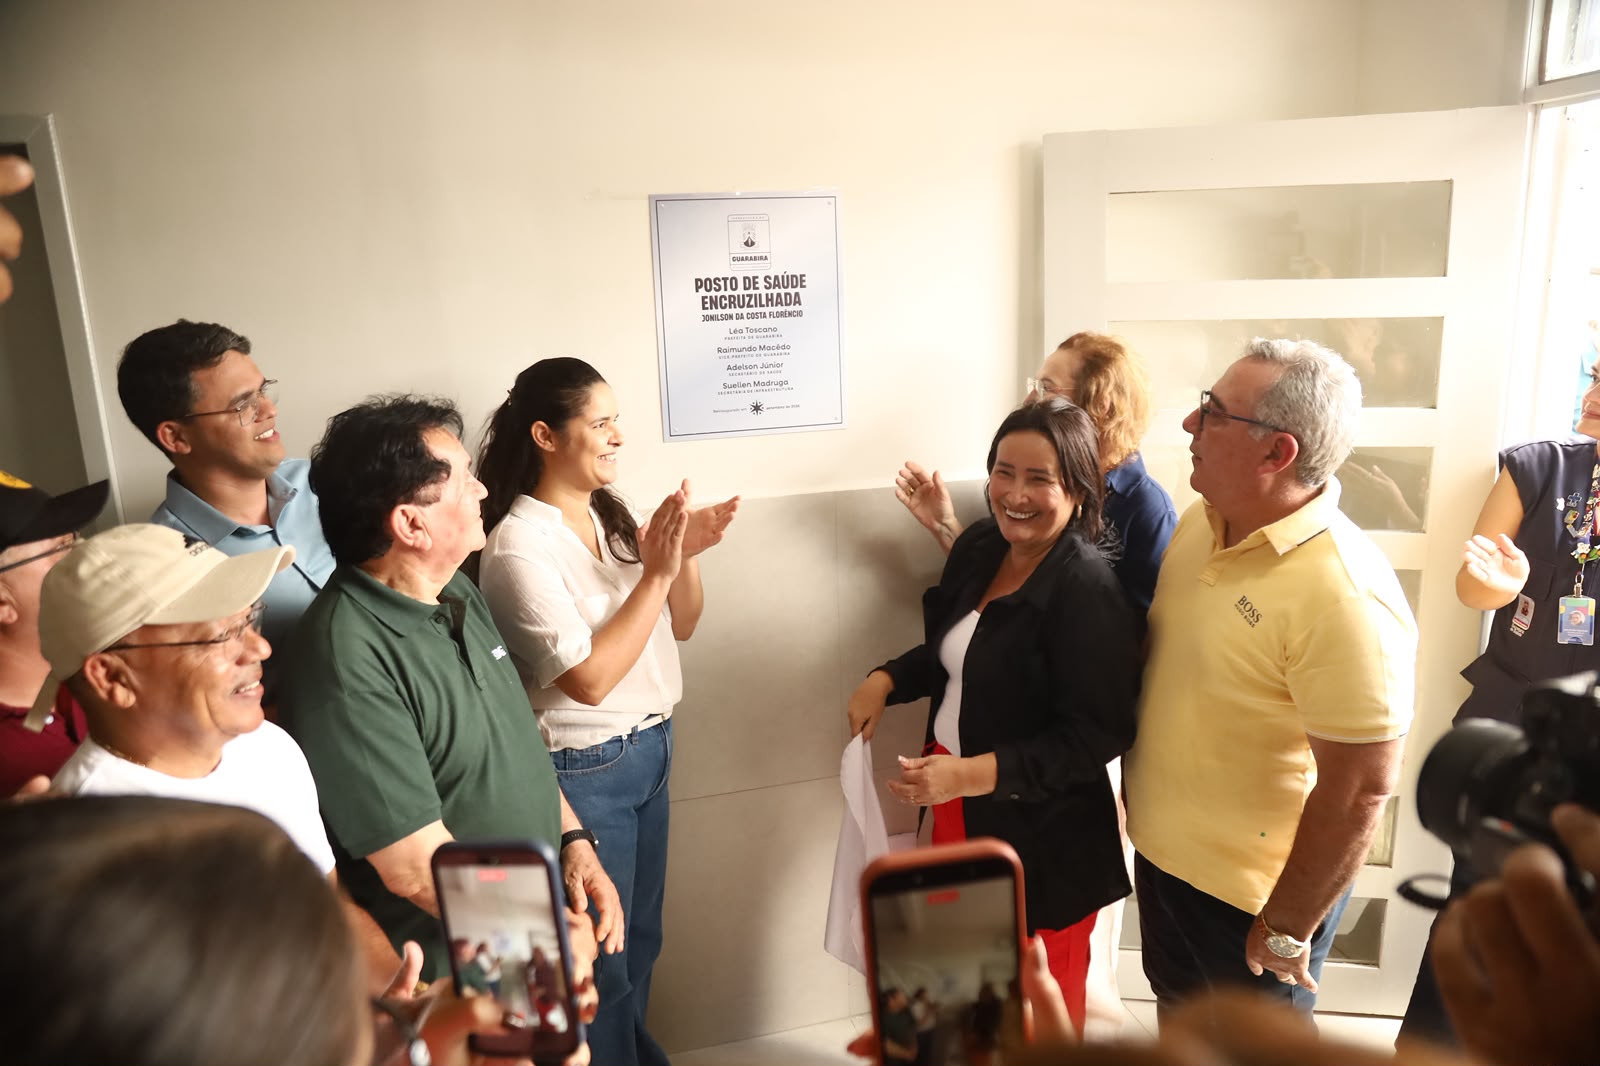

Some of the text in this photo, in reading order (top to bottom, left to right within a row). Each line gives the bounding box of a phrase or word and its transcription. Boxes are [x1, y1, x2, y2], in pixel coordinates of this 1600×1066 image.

[694, 271, 807, 293] POSTO DE SAÚDE
[701, 291, 802, 311] ENCRUZILHADA
[702, 309, 804, 322] JONILSON DA COSTA FLORÊNCIO
[729, 326, 778, 335] Léa Toscano
[717, 345, 758, 354] Raimundo
[726, 362, 784, 371] Adelson Júnior
[722, 379, 789, 390] Suellen Madruga
[1238, 595, 1262, 624] BOSS
